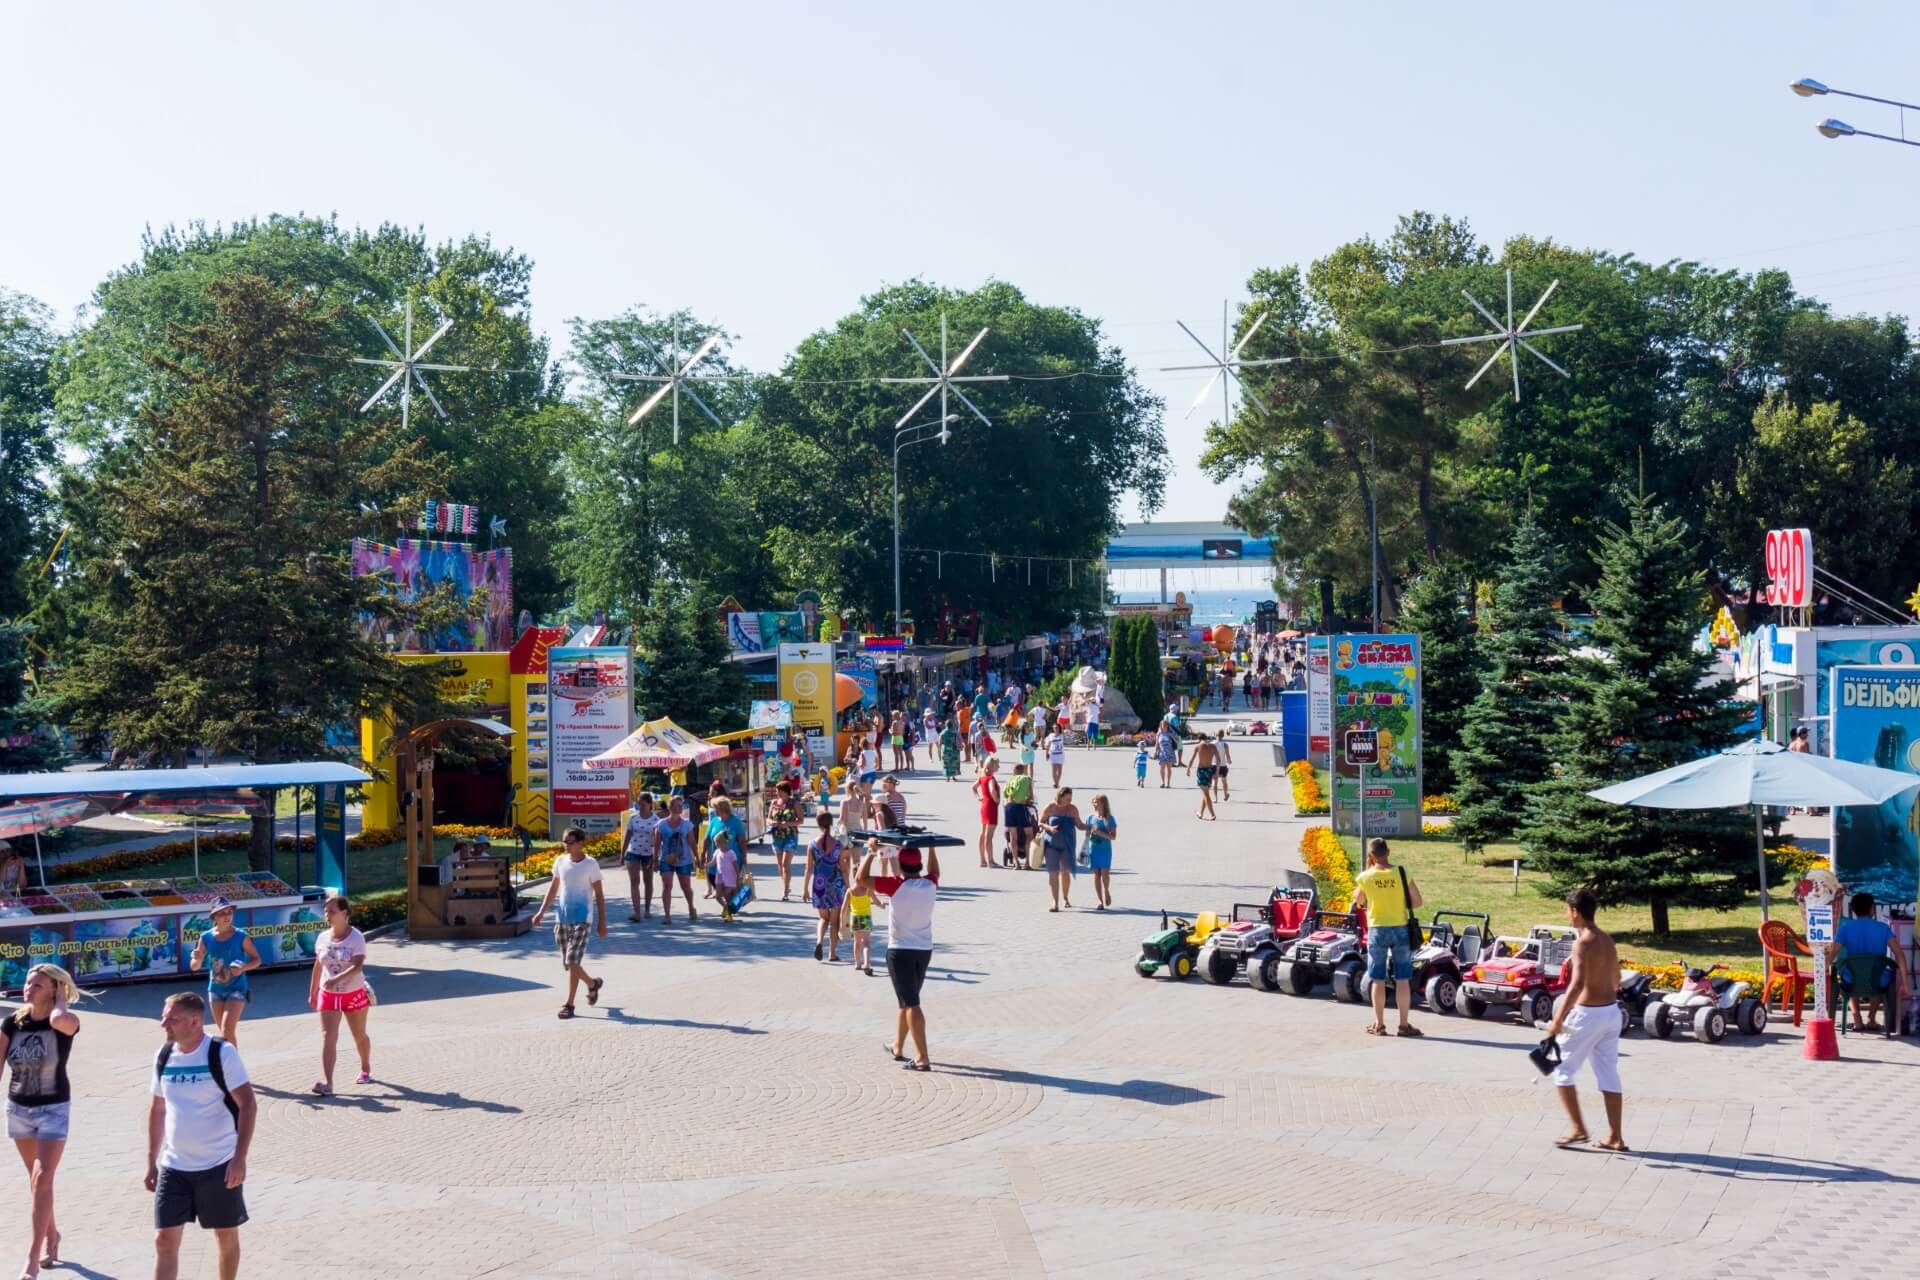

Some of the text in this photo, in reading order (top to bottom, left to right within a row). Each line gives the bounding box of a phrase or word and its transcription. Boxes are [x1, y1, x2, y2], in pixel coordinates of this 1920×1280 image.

[1809, 916, 1816, 927] 4
[1810, 928, 1824, 941] 50
[0, 931, 169, 957] Что еще для счастья надо?
